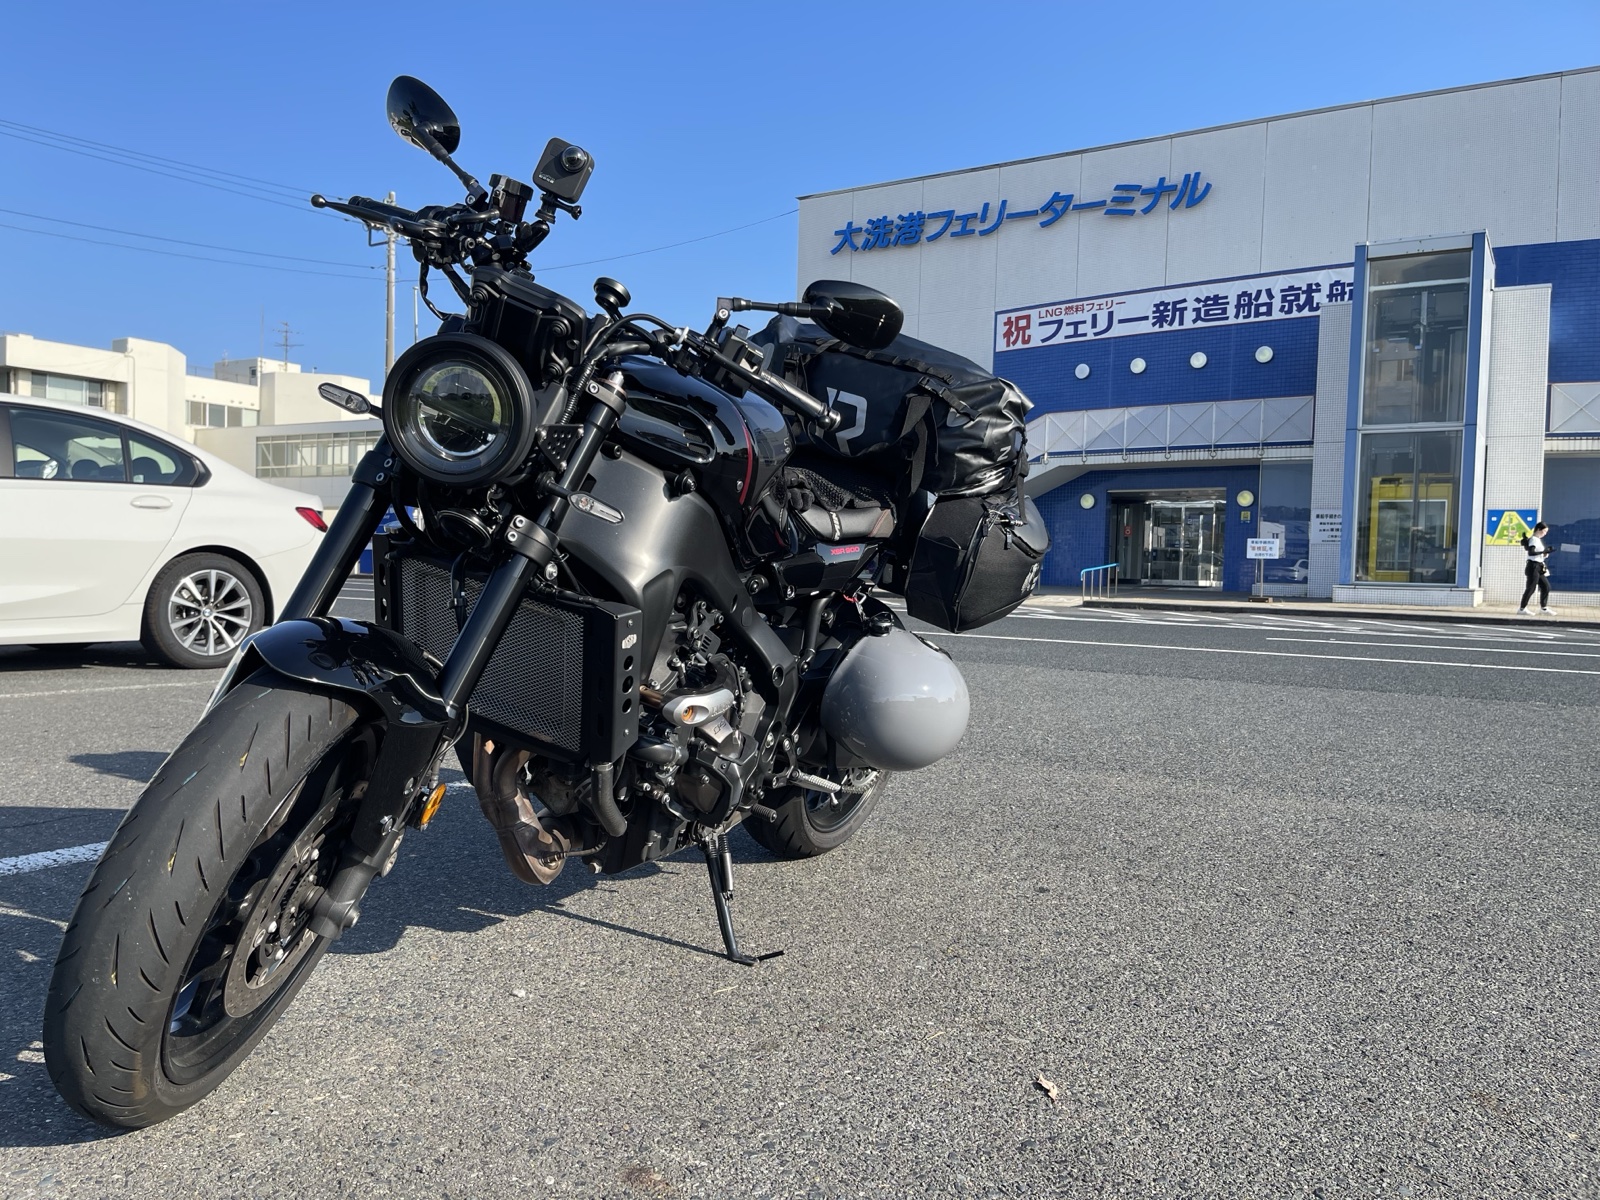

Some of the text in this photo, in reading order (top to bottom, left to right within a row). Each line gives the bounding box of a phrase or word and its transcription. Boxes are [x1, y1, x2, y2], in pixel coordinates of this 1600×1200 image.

[830, 171, 1212, 256] 大洗港フェリーターミナル
[1038, 300, 1127, 319] LNG燃料フェリー
[1002, 314, 1032, 348] 祝
